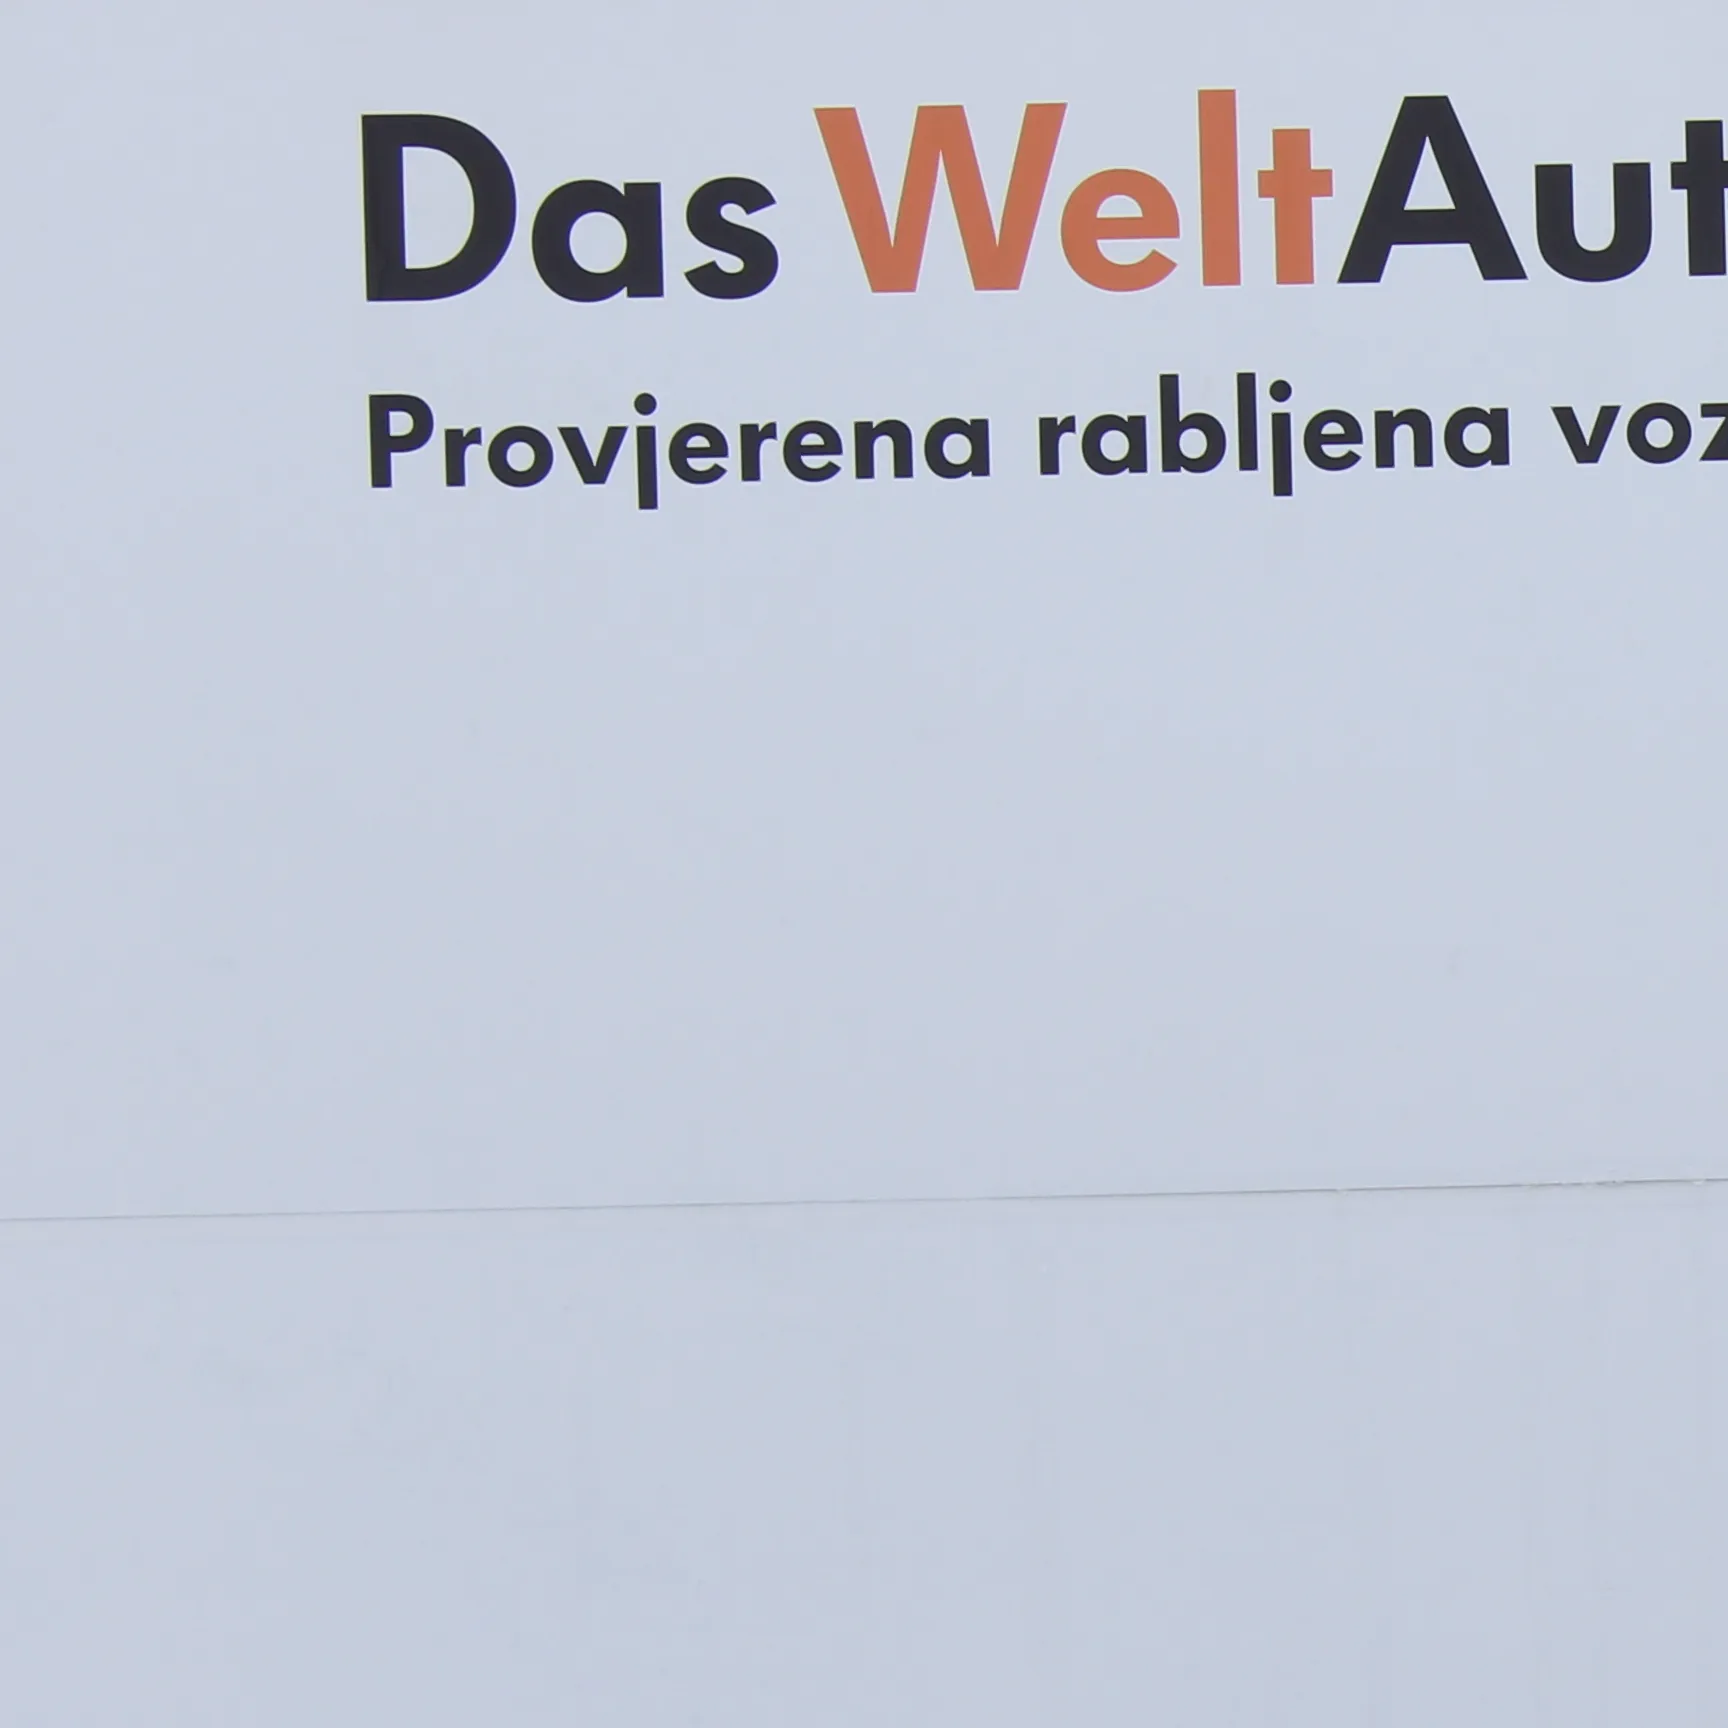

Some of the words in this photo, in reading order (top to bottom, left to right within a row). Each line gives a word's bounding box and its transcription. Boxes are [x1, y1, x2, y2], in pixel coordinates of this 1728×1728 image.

[360, 113, 779, 303] Das
[368, 392, 991, 511] Provjerena
[1038, 371, 1510, 497] rabljena
